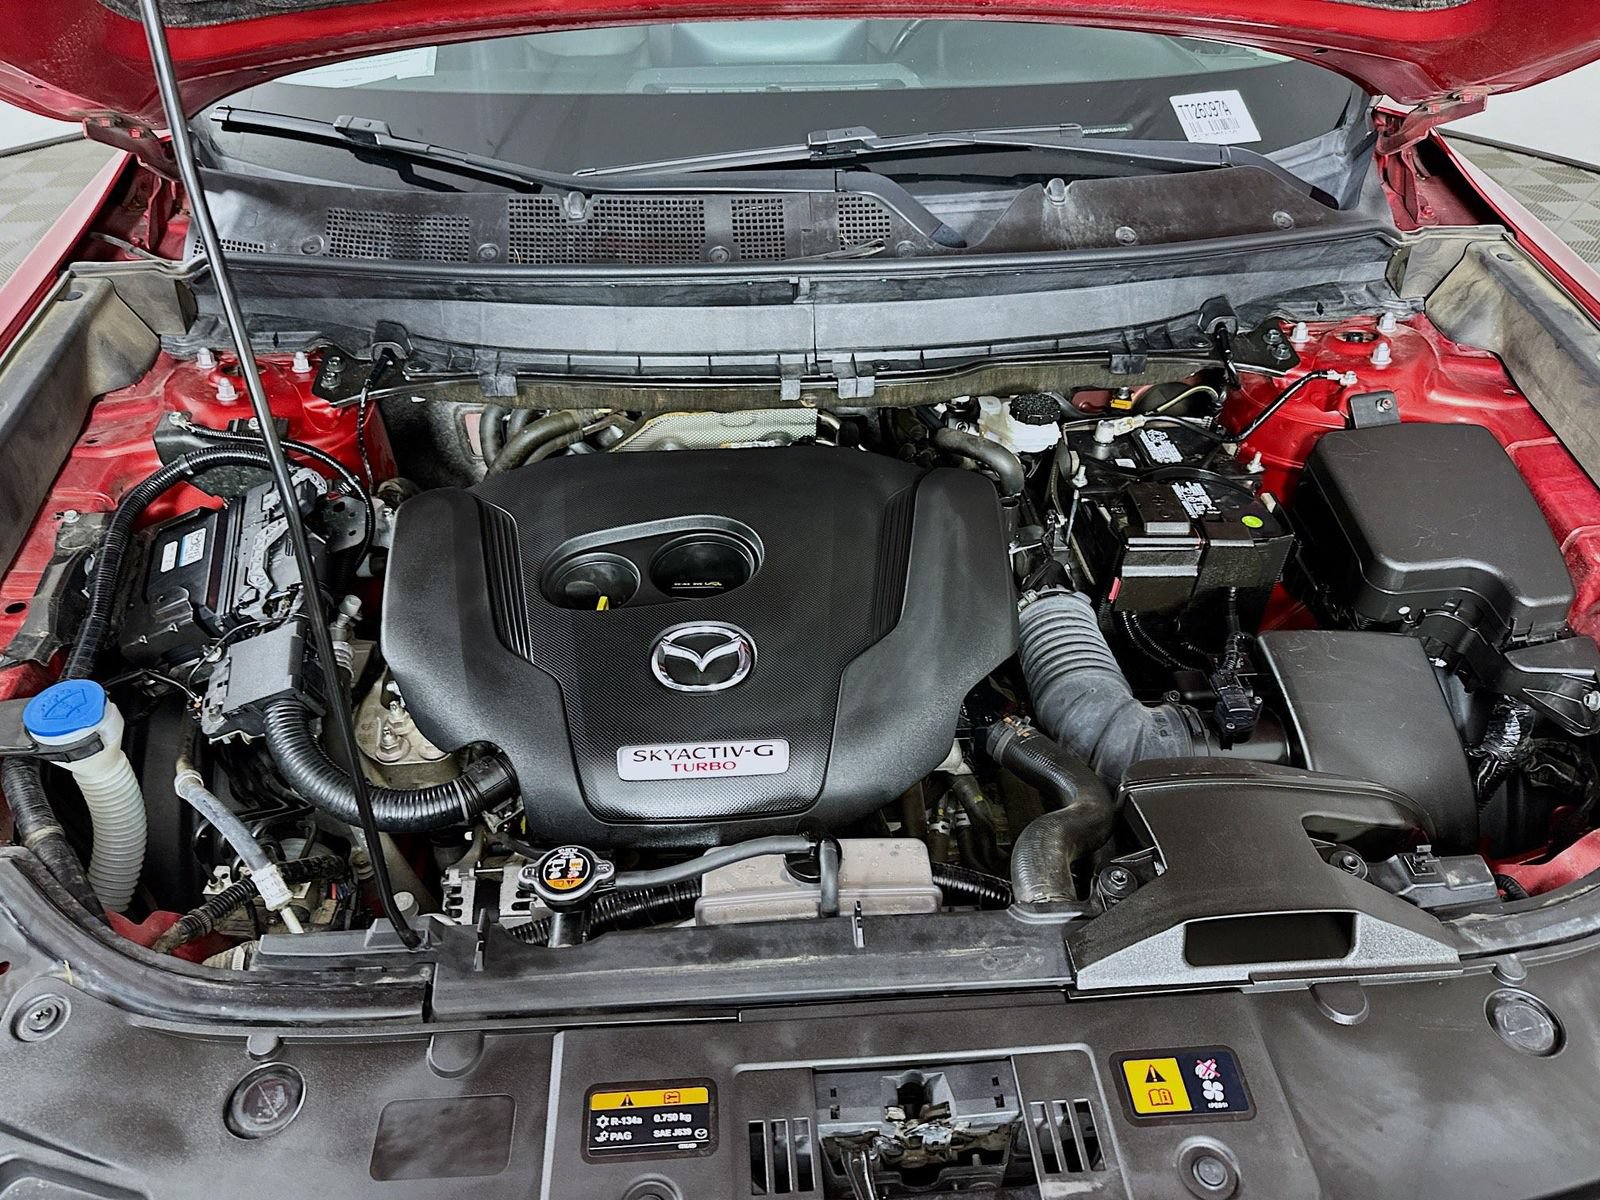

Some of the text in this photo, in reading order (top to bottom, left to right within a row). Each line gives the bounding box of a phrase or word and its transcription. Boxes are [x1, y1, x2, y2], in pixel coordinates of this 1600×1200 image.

[632, 744, 775, 763] SKYACTIV-G
[670, 761, 737, 774] TURBO
[610, 1115, 643, 1126] R-134a
[679, 1112, 692, 1123] kg
[609, 1131, 632, 1142] PAG
[653, 1128, 671, 1138] SAE
